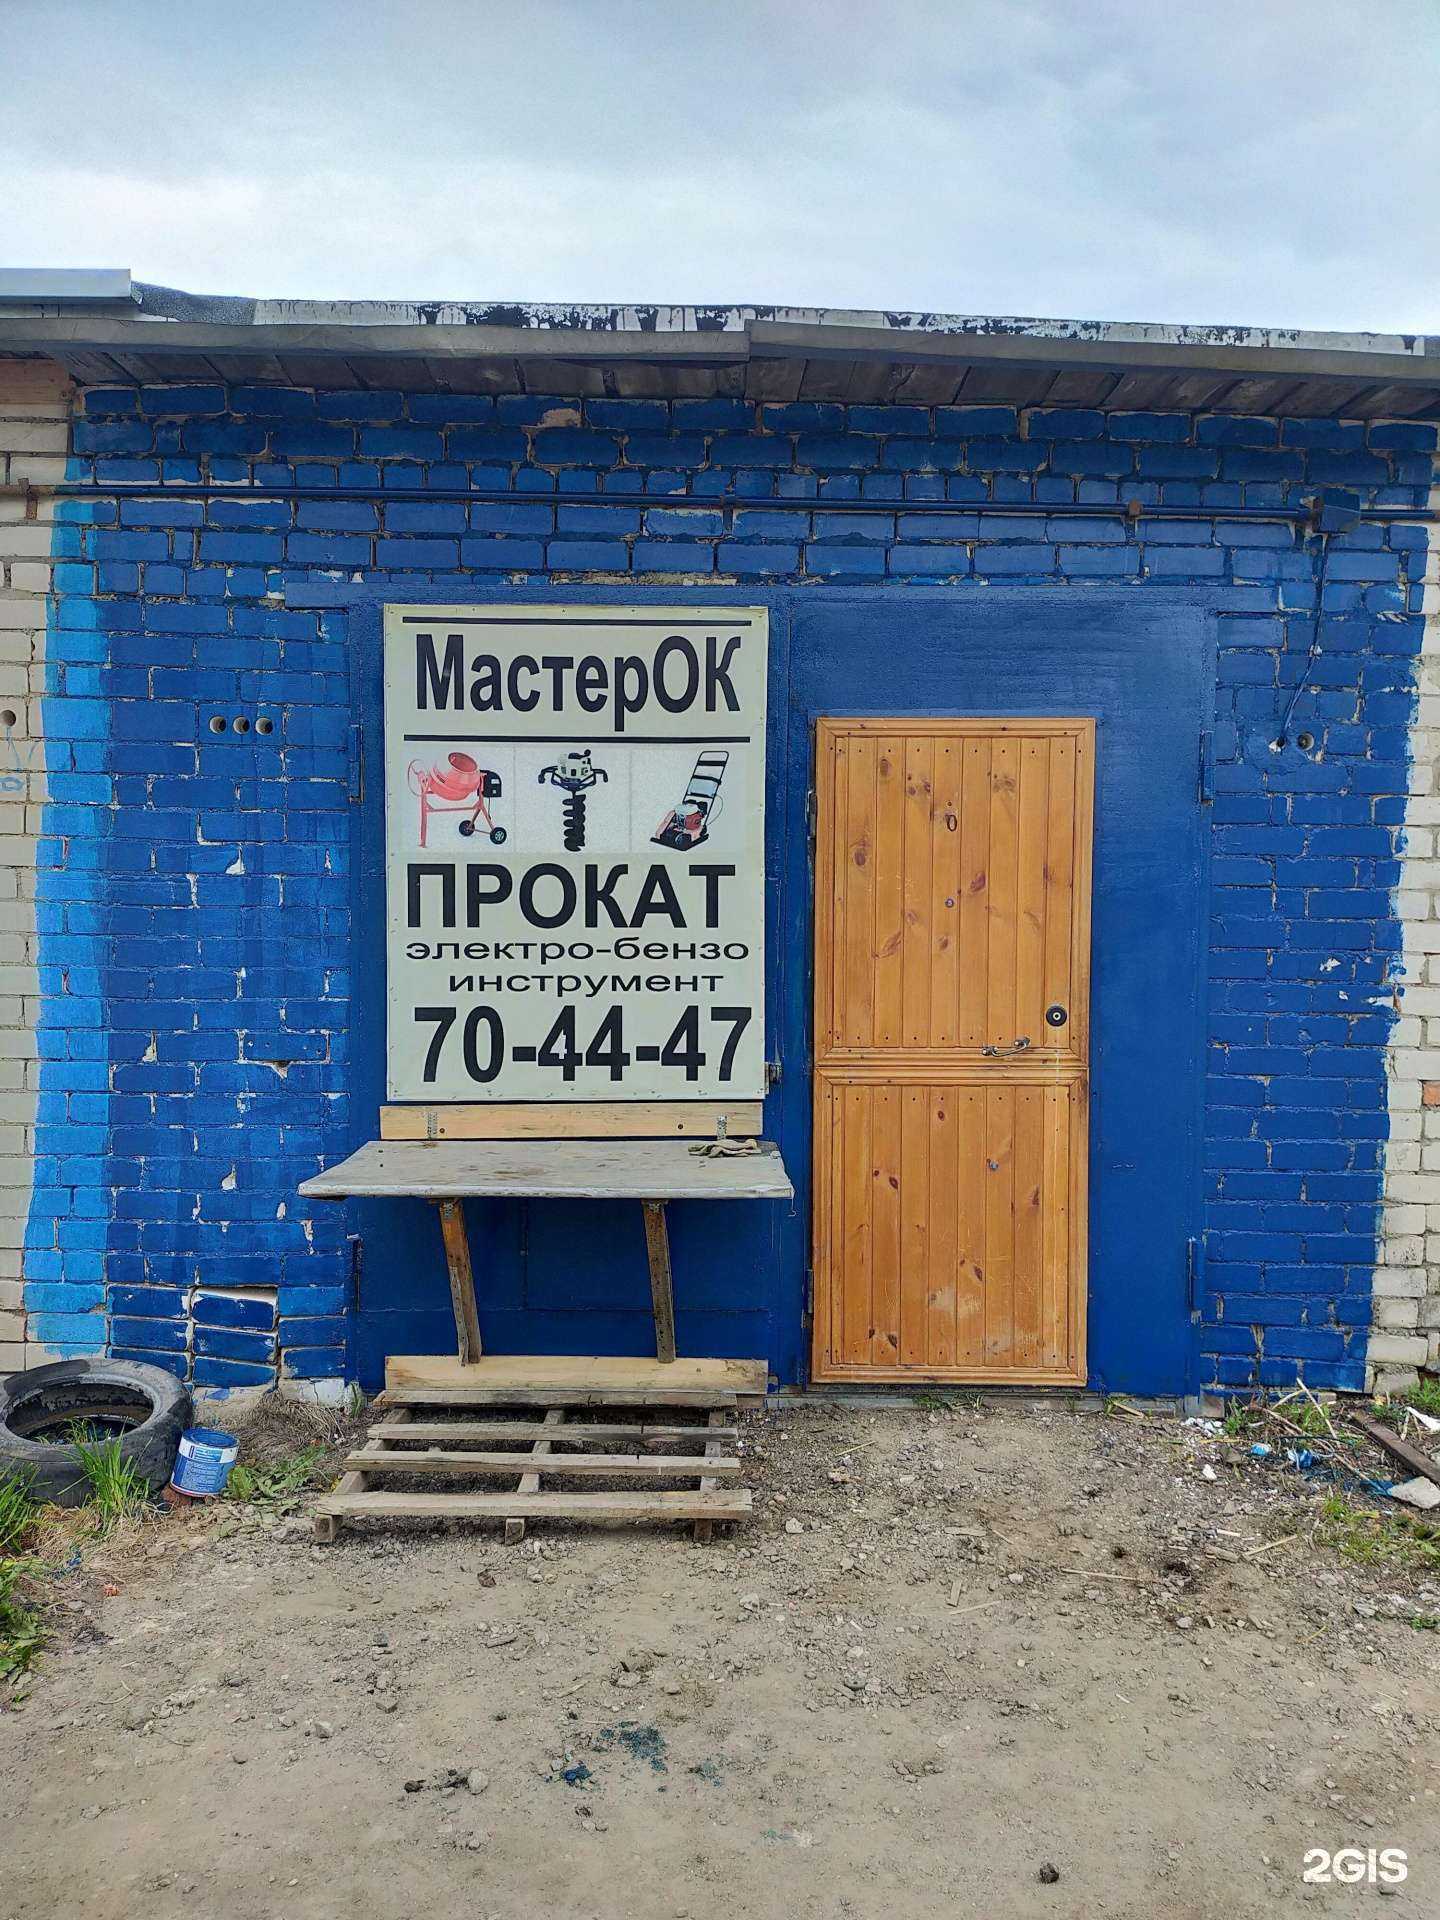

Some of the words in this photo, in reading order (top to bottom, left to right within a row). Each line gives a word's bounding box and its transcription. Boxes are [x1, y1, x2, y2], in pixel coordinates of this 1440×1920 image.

[415, 633, 742, 732] МастерОК
[406, 863, 736, 930] ПРОКАТ
[406, 936, 749, 965] электро-бензо
[448, 973, 725, 998] инструмент
[414, 1004, 752, 1084] 70-44-47
